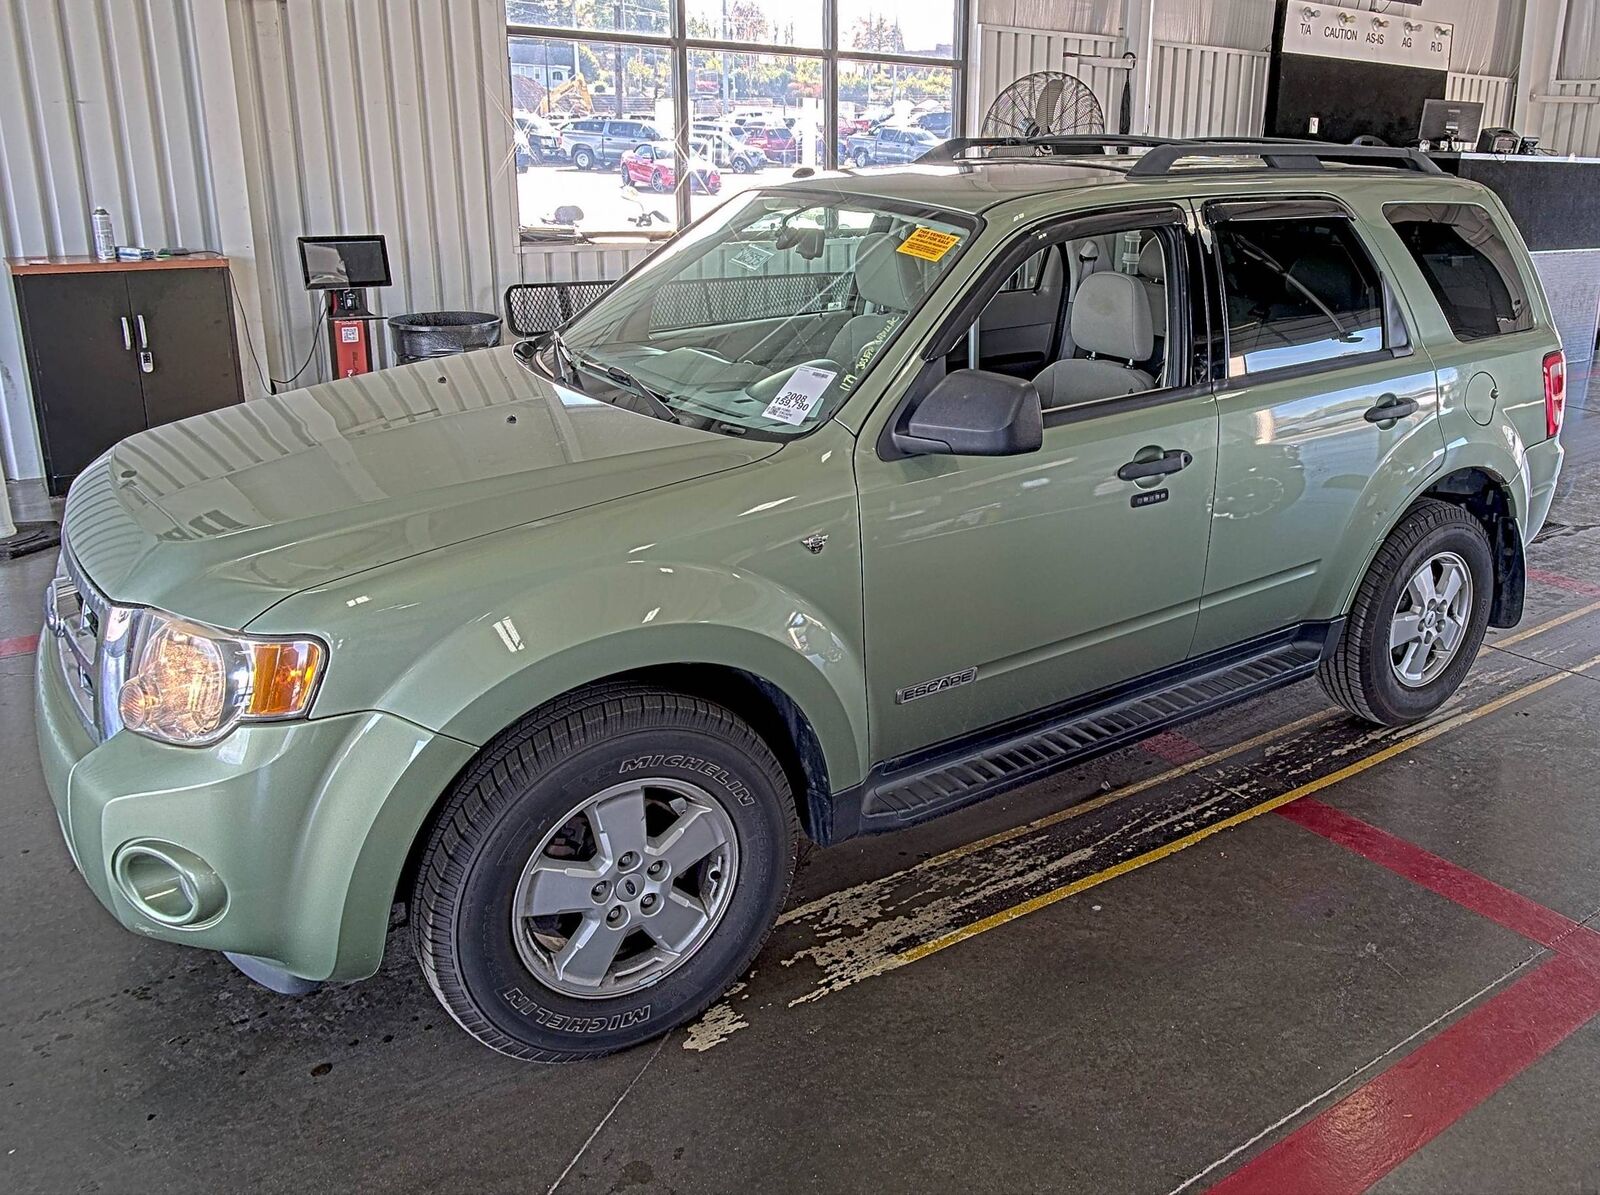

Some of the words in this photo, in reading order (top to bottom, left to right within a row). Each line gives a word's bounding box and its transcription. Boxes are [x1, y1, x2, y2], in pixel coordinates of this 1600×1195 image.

[1300, 23, 1312, 35] T/A
[1324, 26, 1358, 41] CAUTION
[1365, 32, 1385, 45] AS-IS
[1401, 37, 1412, 48] AG
[930, 231, 950, 241] VEHICLE
[938, 238, 950, 246] SALE
[774, 396, 810, 412] 159,790
[785, 391, 808, 403] 2008
[903, 669, 974, 701] ESCAPE
[619, 755, 755, 807] MICHELIN
[503, 987, 651, 1033] MICHELIN
